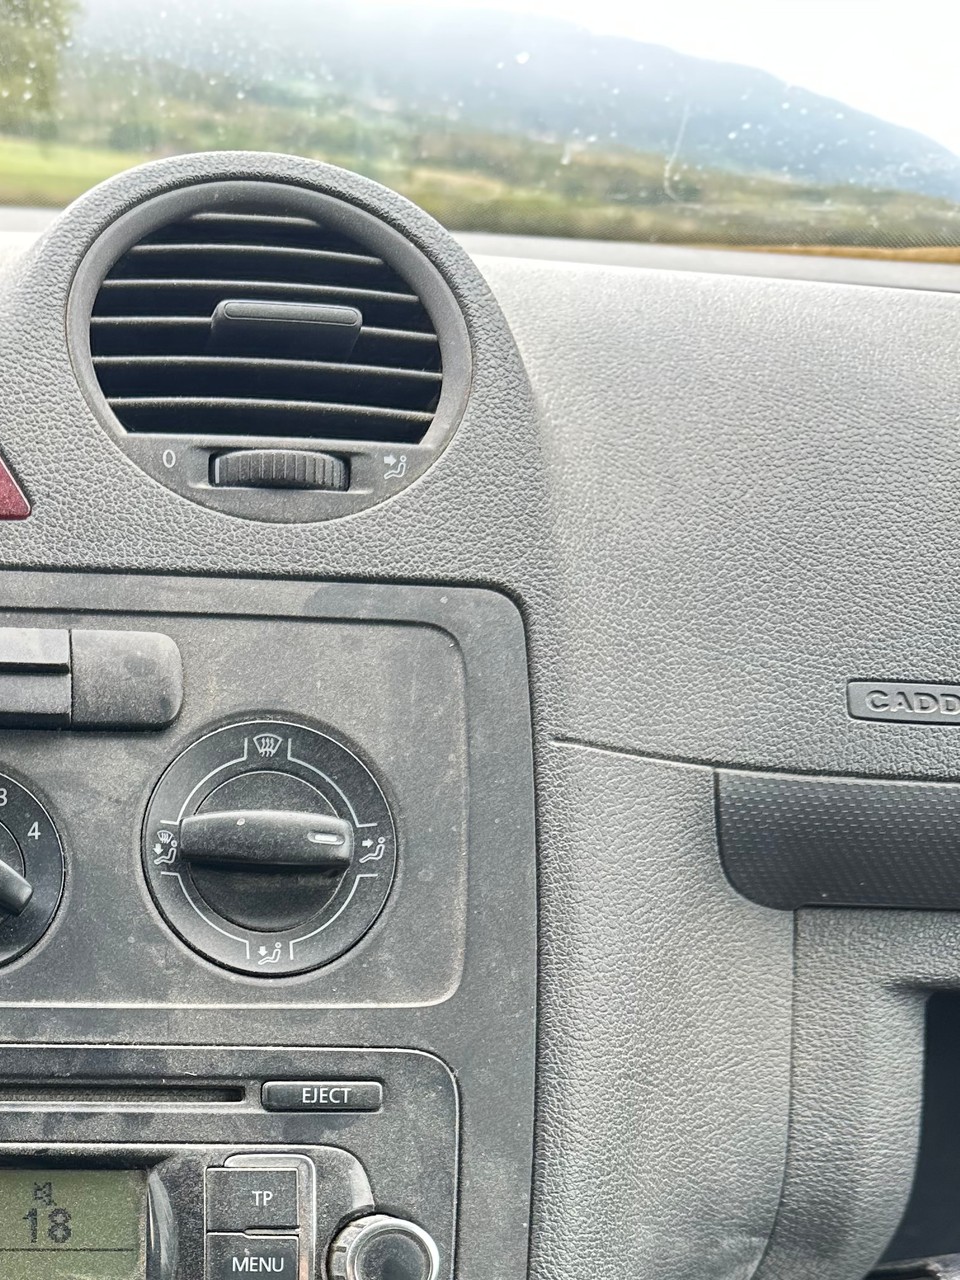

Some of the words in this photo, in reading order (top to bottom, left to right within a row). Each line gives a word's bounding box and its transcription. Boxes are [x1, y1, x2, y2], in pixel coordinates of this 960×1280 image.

[865, 689, 960, 715] CADD
[27, 821, 42, 840] 4
[301, 1087, 352, 1105] EJECT
[252, 1190, 274, 1207] TP
[22, 1208, 73, 1244] 18
[231, 1256, 285, 1273] MENU
